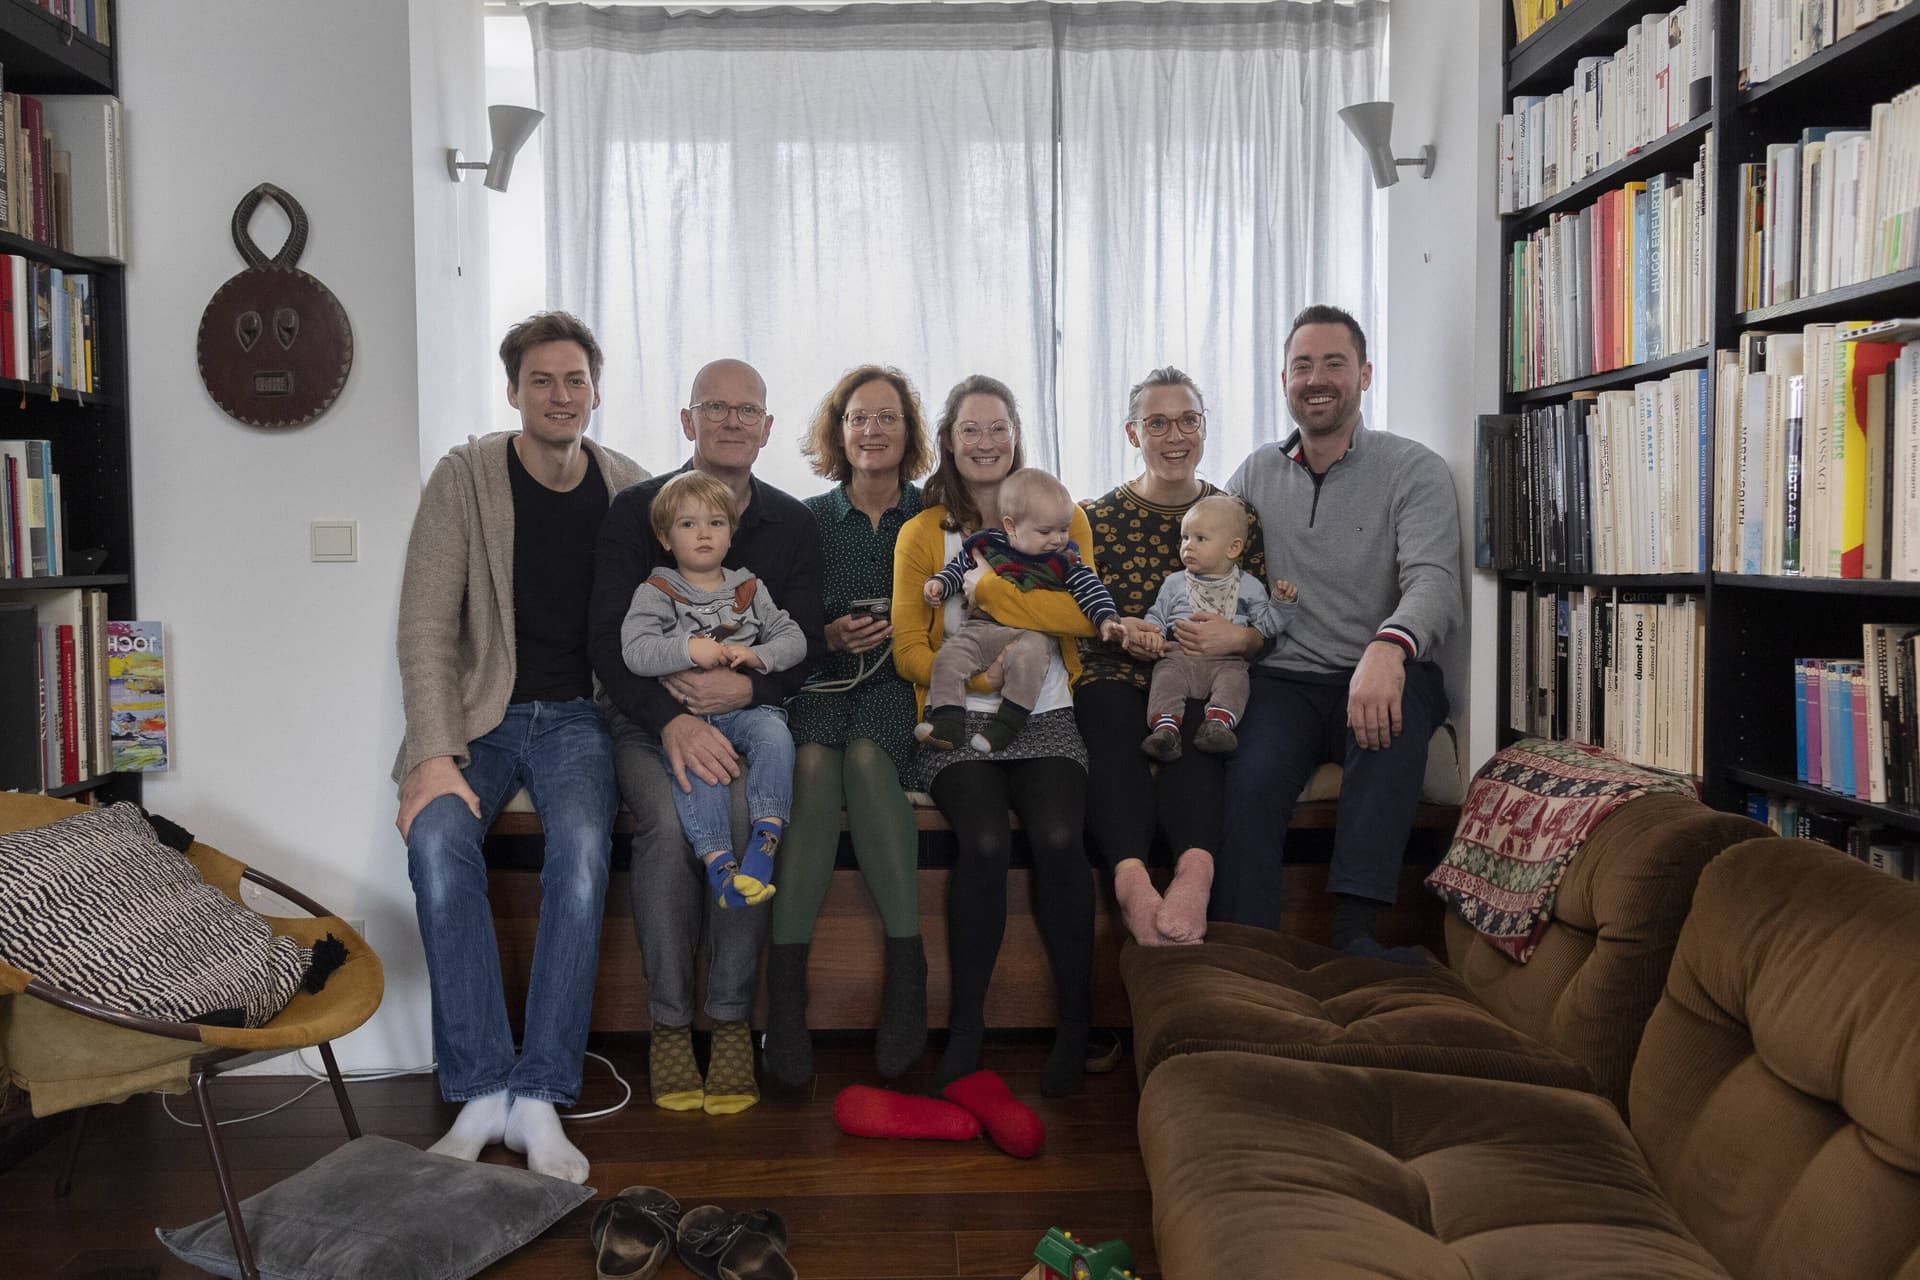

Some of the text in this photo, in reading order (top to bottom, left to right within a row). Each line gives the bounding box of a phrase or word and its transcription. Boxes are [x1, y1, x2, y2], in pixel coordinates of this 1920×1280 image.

[1651, 180, 1661, 293] HUGO ERFURTH
[1816, 425, 1828, 496] PASSAGE
[1788, 504, 1798, 532] ART
[107, 635, 157, 652] JOCH
[1634, 620, 1644, 642] foto
[1634, 644, 1644, 681] dumont
[1647, 621, 1656, 681] dumont foto
